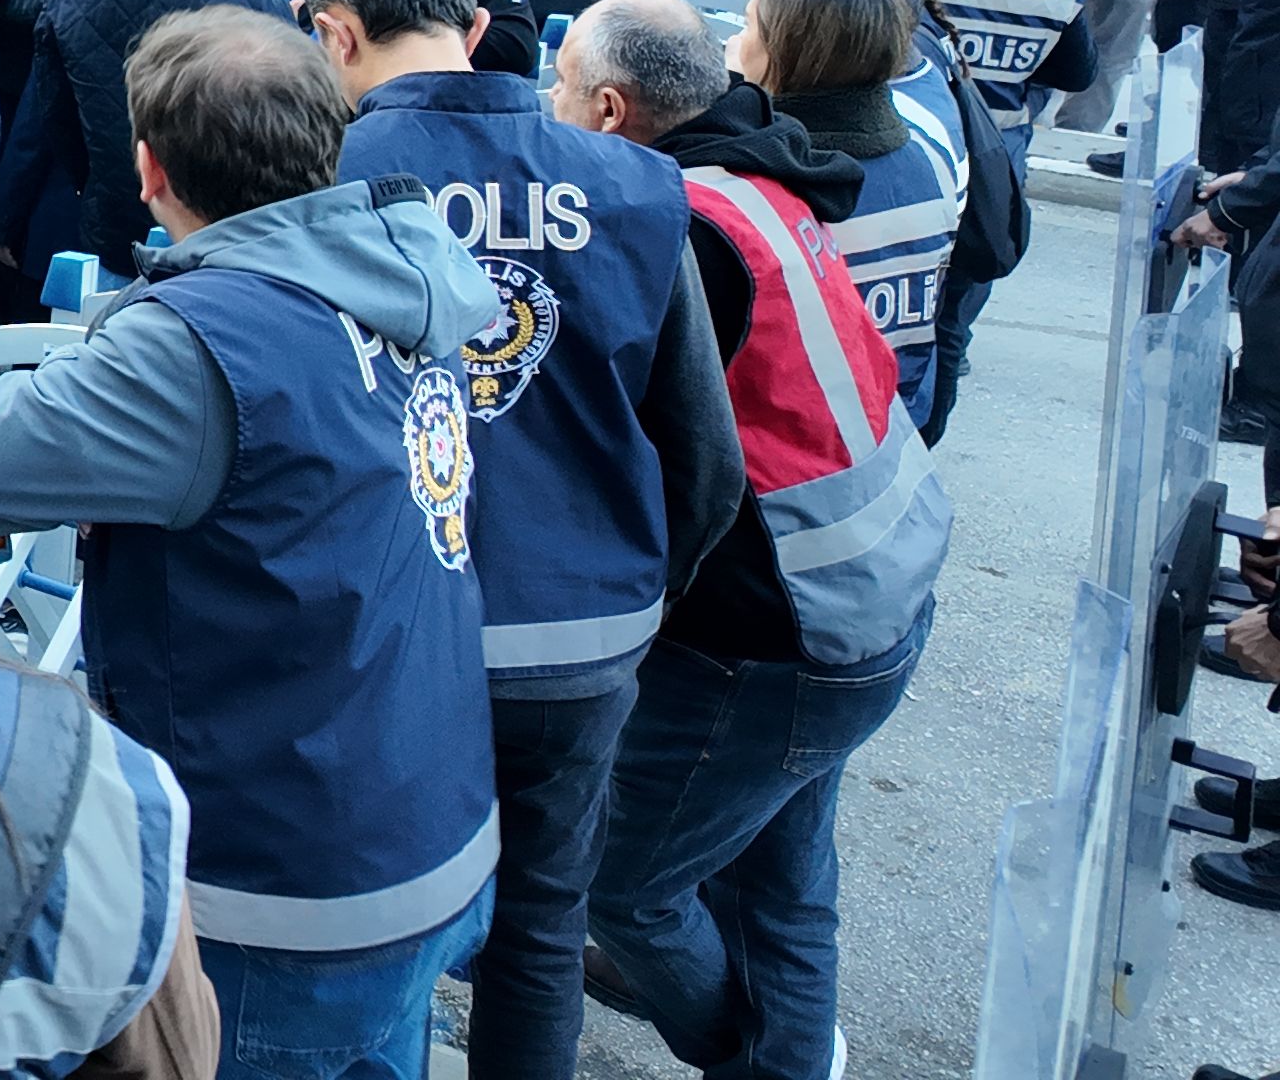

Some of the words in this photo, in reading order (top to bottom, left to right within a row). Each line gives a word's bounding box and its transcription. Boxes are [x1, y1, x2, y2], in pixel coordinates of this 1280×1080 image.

[957, 32, 1040, 70] OLİS
[425, 182, 591, 251] OLİS
[864, 274, 936, 329] OLİ
